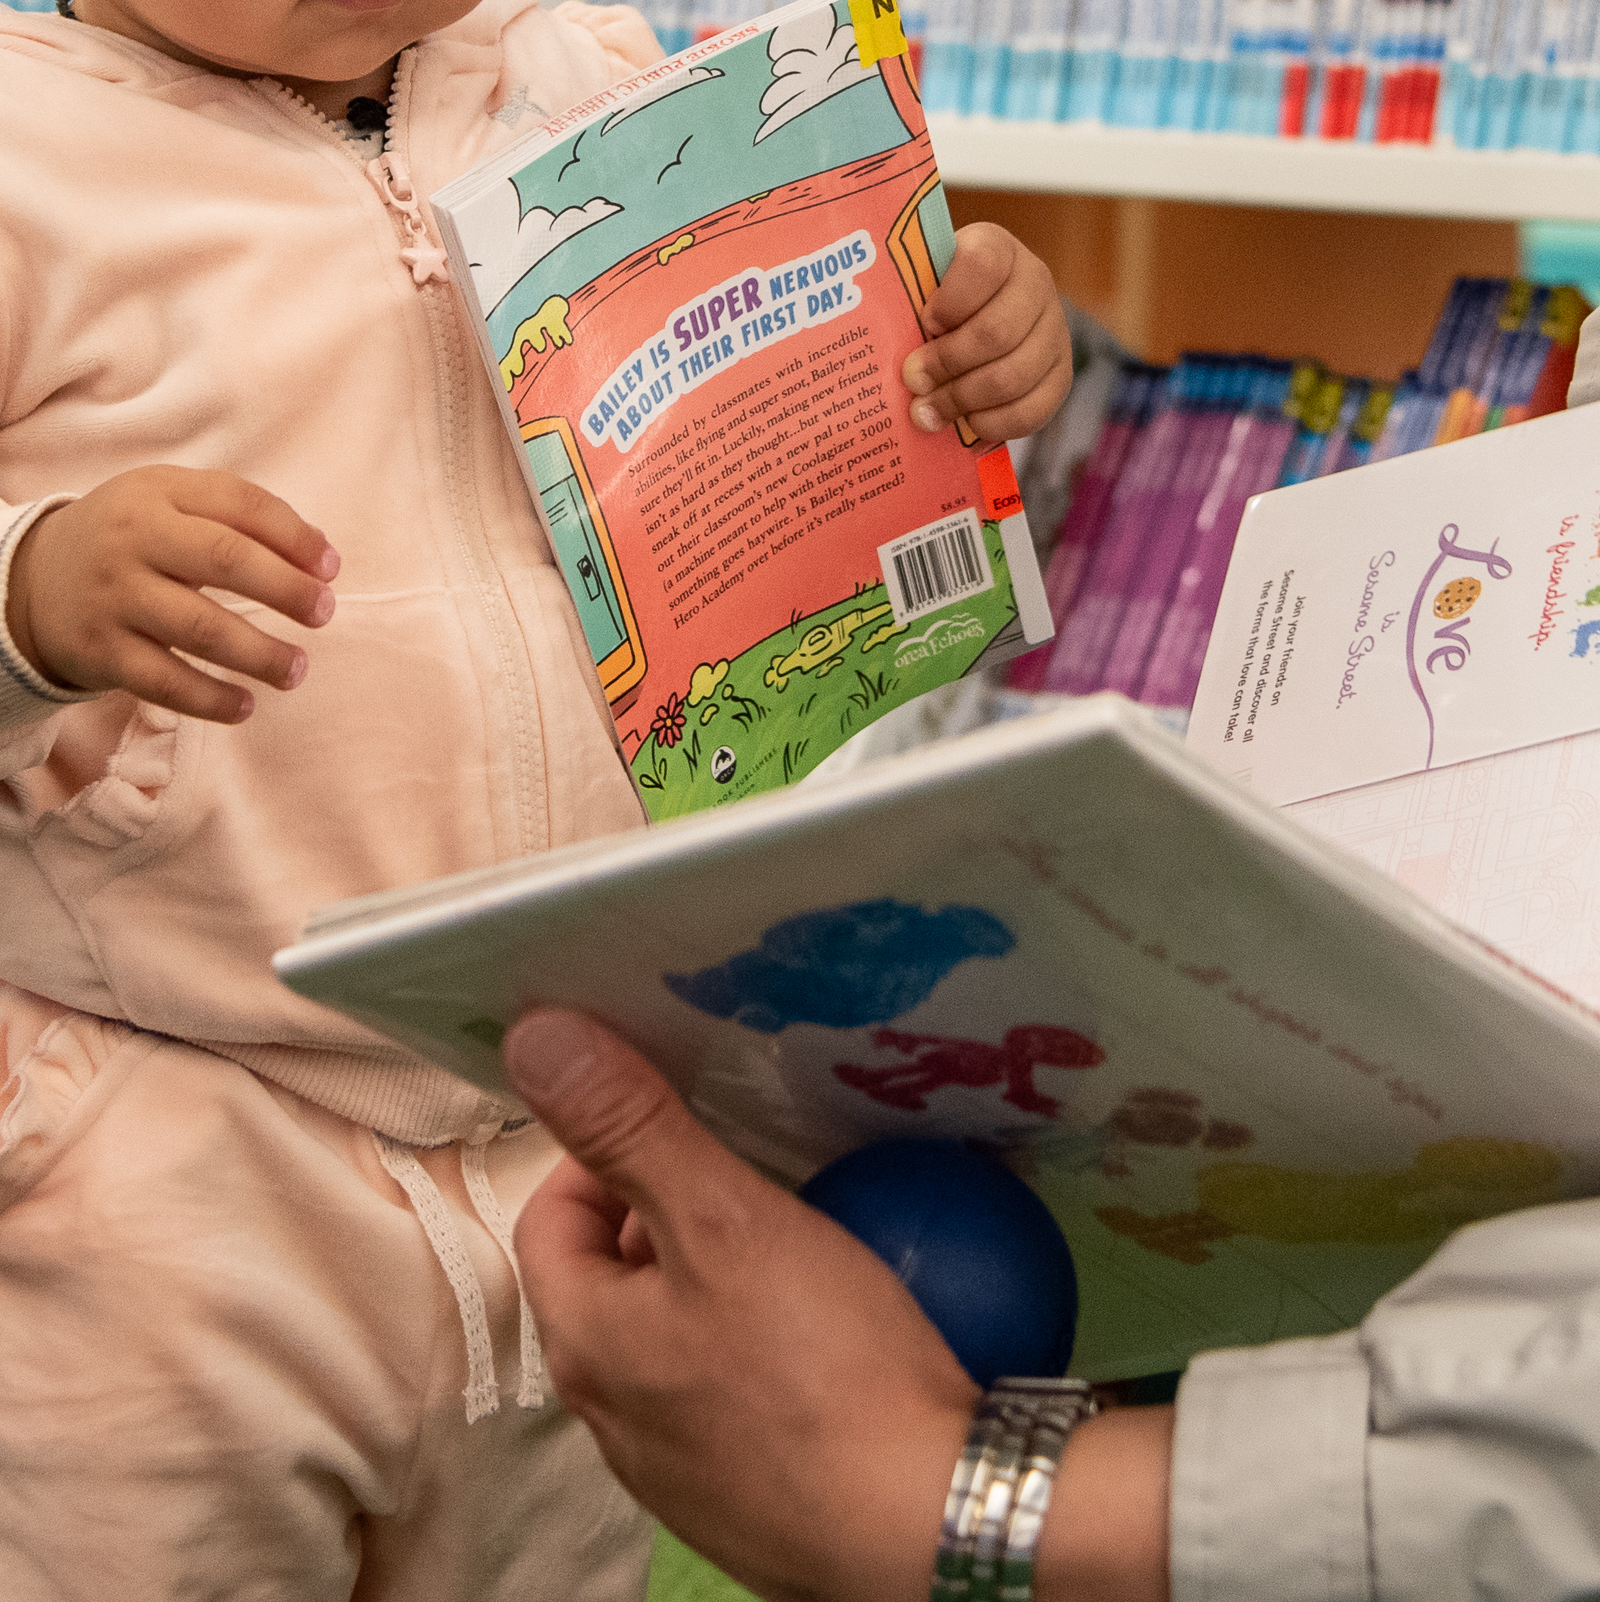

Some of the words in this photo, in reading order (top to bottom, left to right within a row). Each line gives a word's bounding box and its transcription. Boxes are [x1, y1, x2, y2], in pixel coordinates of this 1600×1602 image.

[686, 26, 759, 62] SKOKIE
[623, 59, 685, 97] PUBLIC
[541, 90, 620, 138] LIBRARY
[587, 358, 644, 436] BAILEY
[649, 339, 671, 369] IS
[672, 277, 763, 352] SUPER
[769, 239, 868, 301] NERVOUS
[616, 372, 674, 442] ABOUT
[678, 334, 735, 383] THEIR
[741, 302, 797, 347] FIRST
[807, 282, 853, 318] DAY.
[628, 425, 690, 478] Surrounded
[692, 415, 706, 431] by
[710, 377, 771, 419] classmates
[775, 358, 803, 380] with
[807, 326, 869, 363] incredible
[635, 463, 676, 497] abilities,
[675, 448, 695, 466] like
[695, 426, 726, 452] flying
[727, 409, 747, 431] and
[748, 393, 779, 417] super
[781, 379, 810, 399] snot,
[810, 358, 846, 382] Bailey
[848, 343, 875, 364] isn't
[640, 496, 661, 517] sure
[662, 468, 694, 500] they'll
[694, 460, 707, 476] fit
[707, 452, 722, 467] in.
[721, 425, 766, 456] Luckily,
[766, 400, 810, 429] making
[811, 384, 835, 404] new
[838, 362, 880, 390] friends
[645, 513, 667, 535] isn't
[669, 504, 681, 518] as
[681, 481, 706, 508] hard
[707, 475, 720, 490] as
[720, 458, 743, 479] they
[822, 397, 855, 418] when
[857, 382, 883, 401] they
[651, 526, 681, 555] sneak
[682, 508, 698, 530] off
[700, 503, 712, 518] at
[713, 480, 745, 507] recess
[747, 461, 773, 483] with
[776, 457, 783, 467] a
[786, 440, 810, 460] new
[814, 425, 833, 447] pal
[836, 420, 850, 433] to
[853, 399, 889, 424] check
[657, 554, 676, 573] out
[676, 534, 701, 558] their
[703, 489, 762, 537] classroom's
[765, 473, 788, 494] new
[791, 437, 855, 477] Coolagizer
[859, 417, 893, 442] 3000
[663, 579, 674, 593] (a
[674, 546, 716, 583] machine
[716, 521, 749, 551] meant
[749, 513, 761, 526] to
[762, 496, 787, 517] help
[788, 479, 815, 500] with
[816, 464, 844, 485] their
[846, 437, 899, 472] powers),
[668, 566, 721, 611] something
[721, 547, 746, 572] goes
[746, 516, 794, 550] haywire.
[795, 505, 807, 518] Is
[809, 478, 854, 510] Bailey's
[857, 463, 886, 483] time
[889, 455, 902, 468] at
[1559, 514, 1580, 537] is
[673, 605, 700, 630] Hero
[700, 569, 745, 609] Academy
[746, 551, 769, 573] over
[770, 529, 804, 556] before
[806, 516, 823, 533] it's
[825, 498, 857, 522] really
[859, 470, 906, 503] started?
[1259, 579, 1273, 600] the
[1274, 568, 1295, 614] Sesame
[1292, 596, 1306, 618] Join
[1354, 550, 1396, 633] Sesame
[1527, 541, 1576, 652] friendship.
[1251, 601, 1269, 635] forms
[1266, 615, 1283, 650] Street
[1286, 620, 1298, 645] your
[1381, 610, 1401, 633] is
[1245, 636, 1259, 660] that
[1259, 653, 1271, 676] and
[1274, 648, 1295, 689] friends
[1238, 662, 1254, 687] love
[1336, 634, 1376, 710] Street.
[1231, 689, 1244, 711] can
[1247, 678, 1267, 725] discover
[1270, 691, 1281, 706] on
[1223, 712, 1240, 744] take!
[1242, 728, 1254, 744] all
[713, 790, 733, 807] OOK
[735, 748, 777, 789] PUBLISHERS
